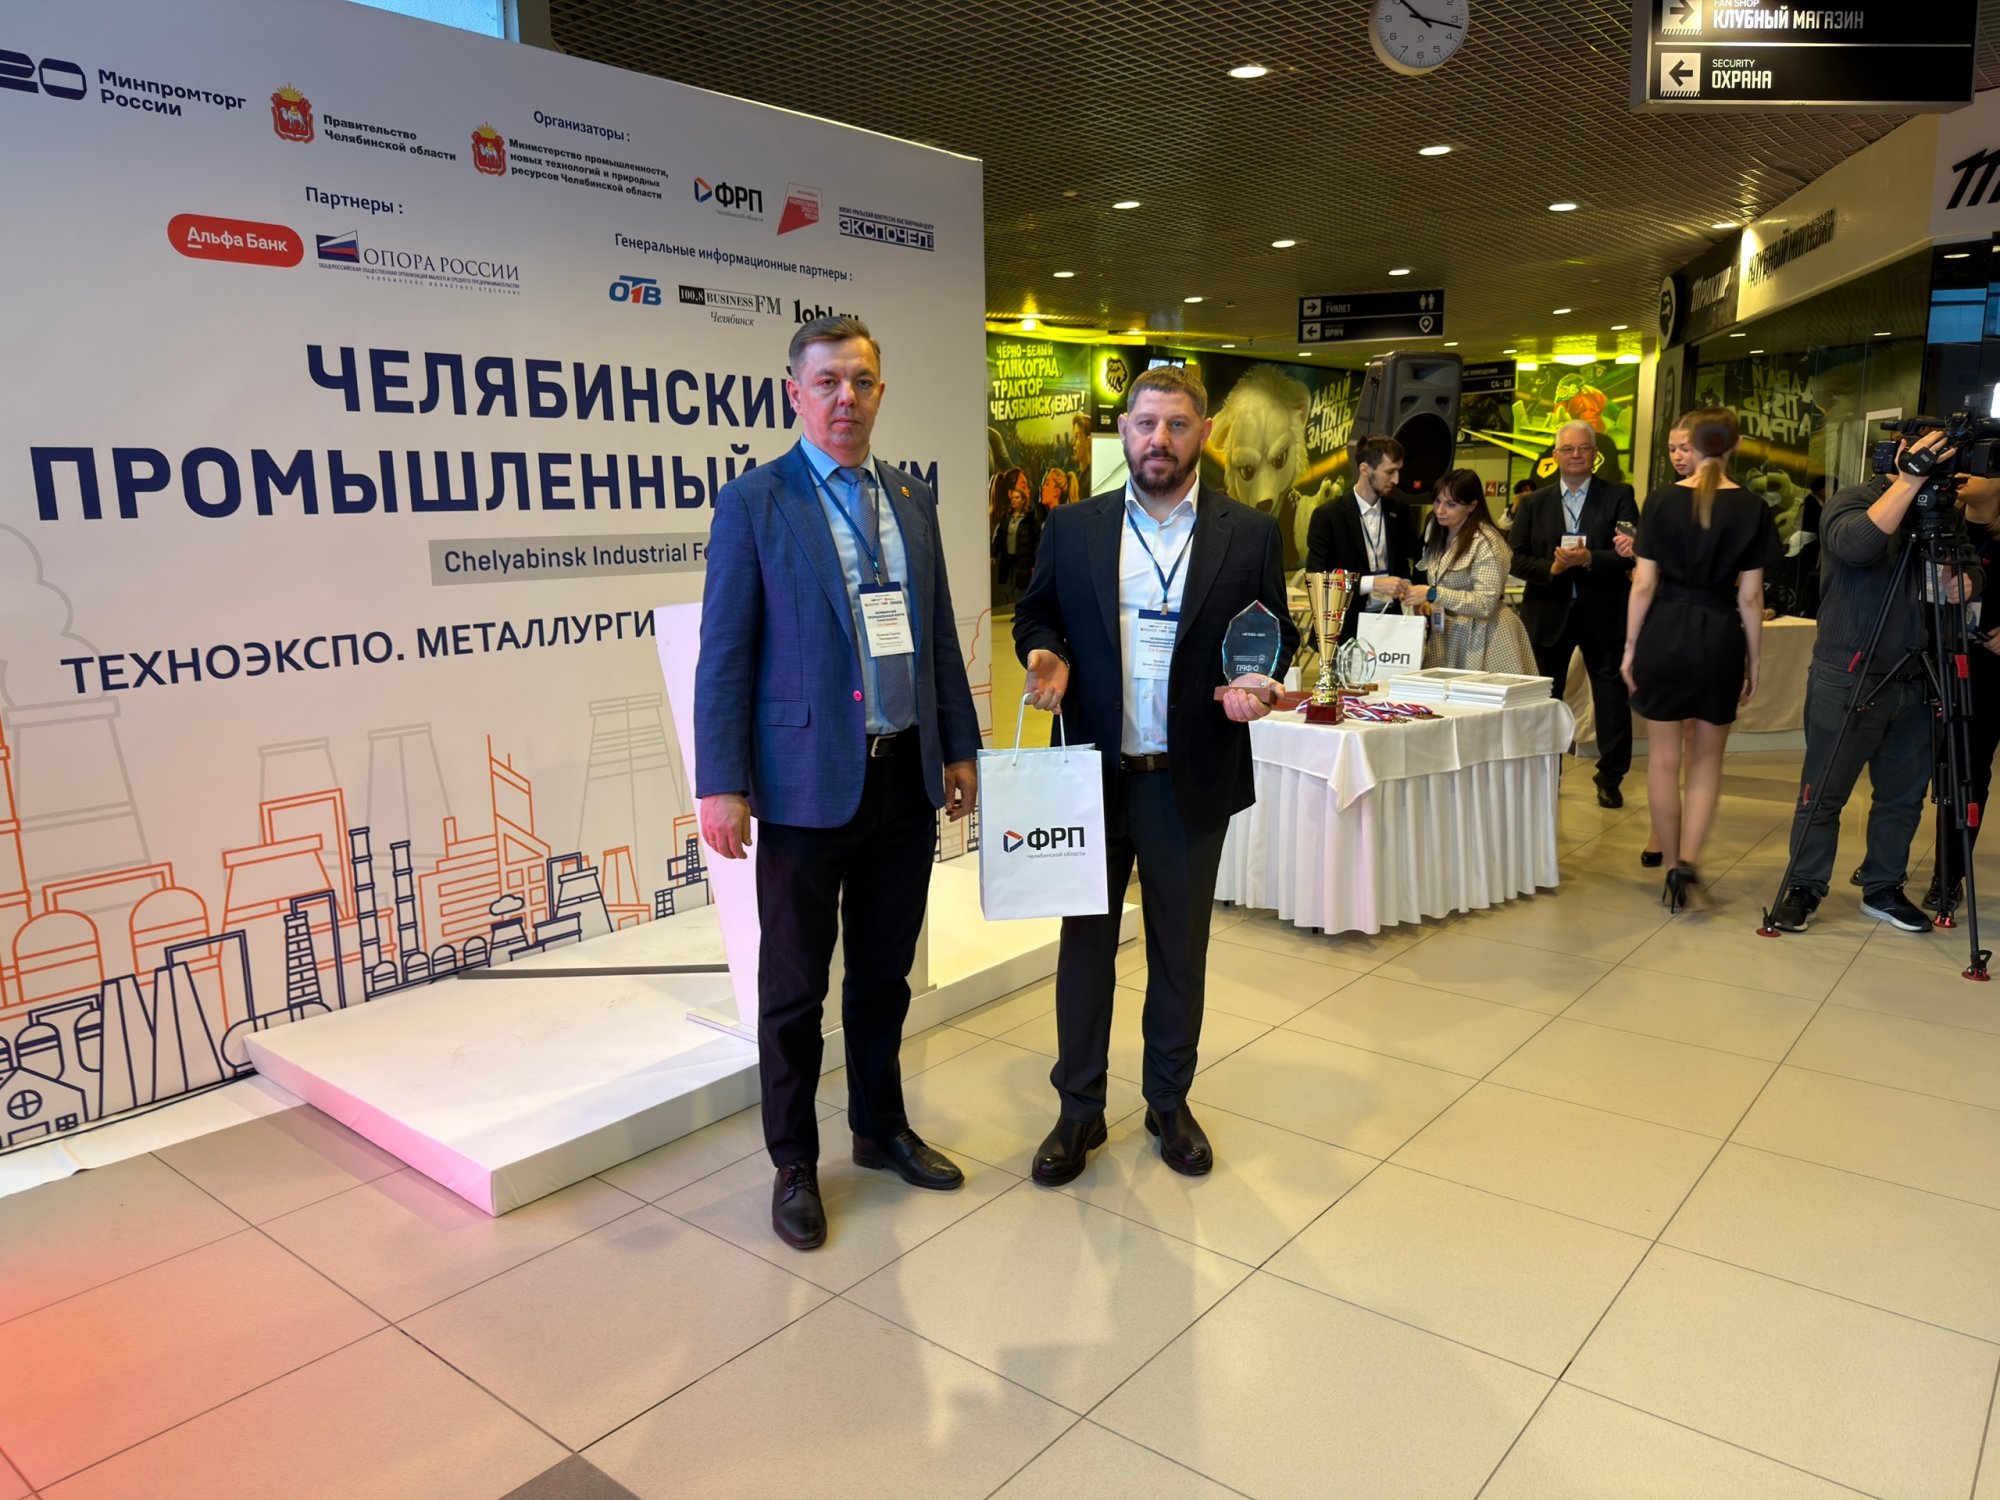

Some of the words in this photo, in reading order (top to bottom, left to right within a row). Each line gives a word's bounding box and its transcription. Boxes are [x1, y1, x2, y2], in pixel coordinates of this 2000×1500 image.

[1384, 15, 1393, 23] 9
[1451, 15, 1459, 23] 3
[1713, 5, 1789, 29] КЛУБНЫЙ
[1793, 10, 1864, 29] МАГАЗИН
[1389, 32, 1397, 40] 8
[1712, 59, 1755, 68] SECURITY
[98, 69, 247, 110] Минпромторг
[1712, 70, 1772, 89] ОХРАНА
[100, 89, 182, 117] России
[323, 114, 417, 140] Правительство
[533, 110, 625, 141] Организаторы
[325, 129, 406, 152] Челябинской
[410, 145, 456, 161] области
[509, 138, 582, 161] Министерство
[584, 154, 669, 179] промышленности,
[510, 153, 543, 165] новых
[545, 159, 601, 177] технологий
[603, 170, 609, 178] и
[611, 171, 660, 188] природных
[511, 167, 559, 182] ресурсов
[560, 173, 623, 192] Челябинской
[626, 187, 662, 200] области
[306, 186, 394, 215] Партнеры
[714, 182, 763, 213] ФРП
[187, 226, 244, 249] Альфа
[246, 233, 288, 252] Банк
[839, 217, 930, 248] ЭКСПОЧЕЛ
[364, 248, 436, 272] ОПОРА
[440, 257, 520, 281] РОССИИ
[615, 233, 696, 258] Генеральные
[698, 248, 797, 273] информационные
[799, 264, 848, 282] партнеры
[680, 287, 704, 302] 100.8
[706, 291, 754, 308] BUSINESS
[754, 295, 782, 316] FM
[710, 311, 755, 327] Челябинск
[996, 357, 1064, 379] ТАНКОГРАД,
[992, 377, 1043, 399] ТРАКТОР
[1320, 419, 1354, 454] ТРАКТ
[444, 546, 587, 574] Chelyabinsk
[593, 543, 687, 566] Industrial
[60, 630, 404, 694] ТЕХНОЭКСПО.
[417, 609, 656, 659] МЕТАЛЛУРГИ
[1378, 651, 1410, 665] ФРП
[1027, 827, 1085, 850] ФРП
